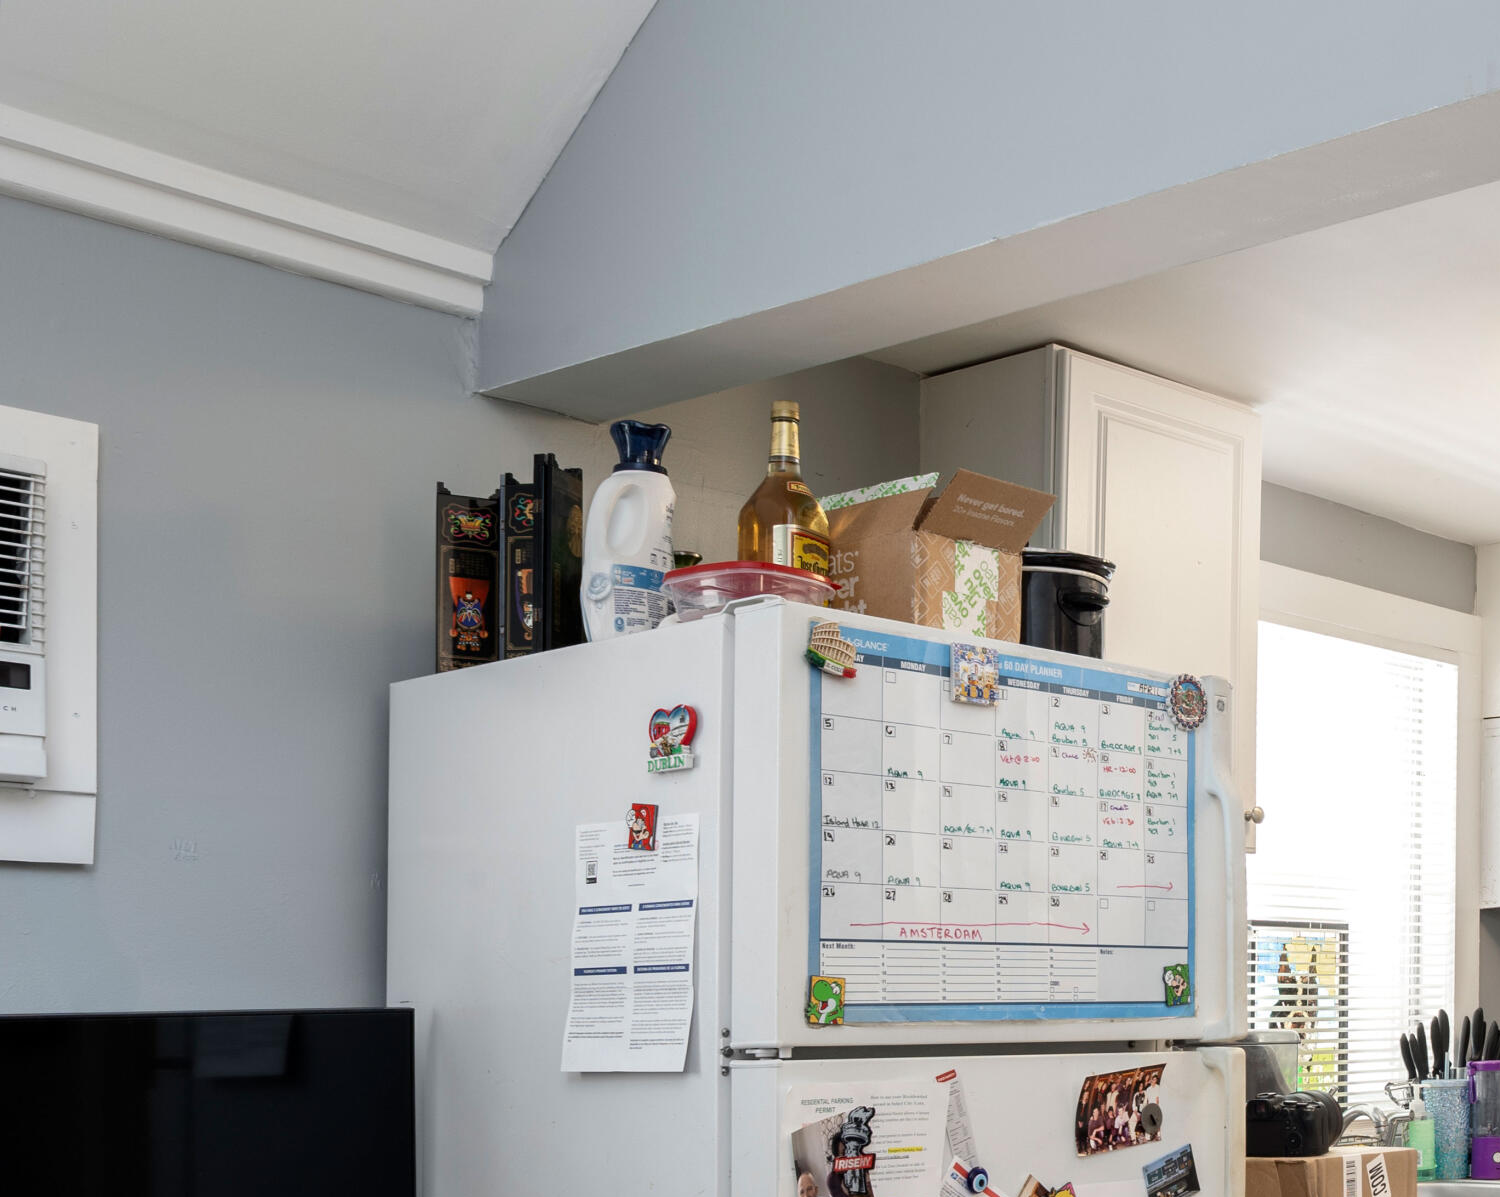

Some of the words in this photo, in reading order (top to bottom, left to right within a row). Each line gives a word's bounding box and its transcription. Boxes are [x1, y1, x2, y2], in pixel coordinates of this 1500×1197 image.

[828, 549, 860, 576] ats
[900, 660, 927, 672] MONDAY
[1014, 662, 1029, 673] DAY
[1030, 664, 1063, 679] PLANNER
[1007, 678, 1041, 690] WEDNESDAY
[647, 755, 685, 773] DUBLIN
[826, 869, 849, 879] AQUA
[822, 886, 835, 897] 26
[885, 890, 896, 901] 27
[899, 926, 983, 941] AMSTERDAM
[831, 1097, 854, 1105] PARKING
[815, 1106, 836, 1114] PERMIT
